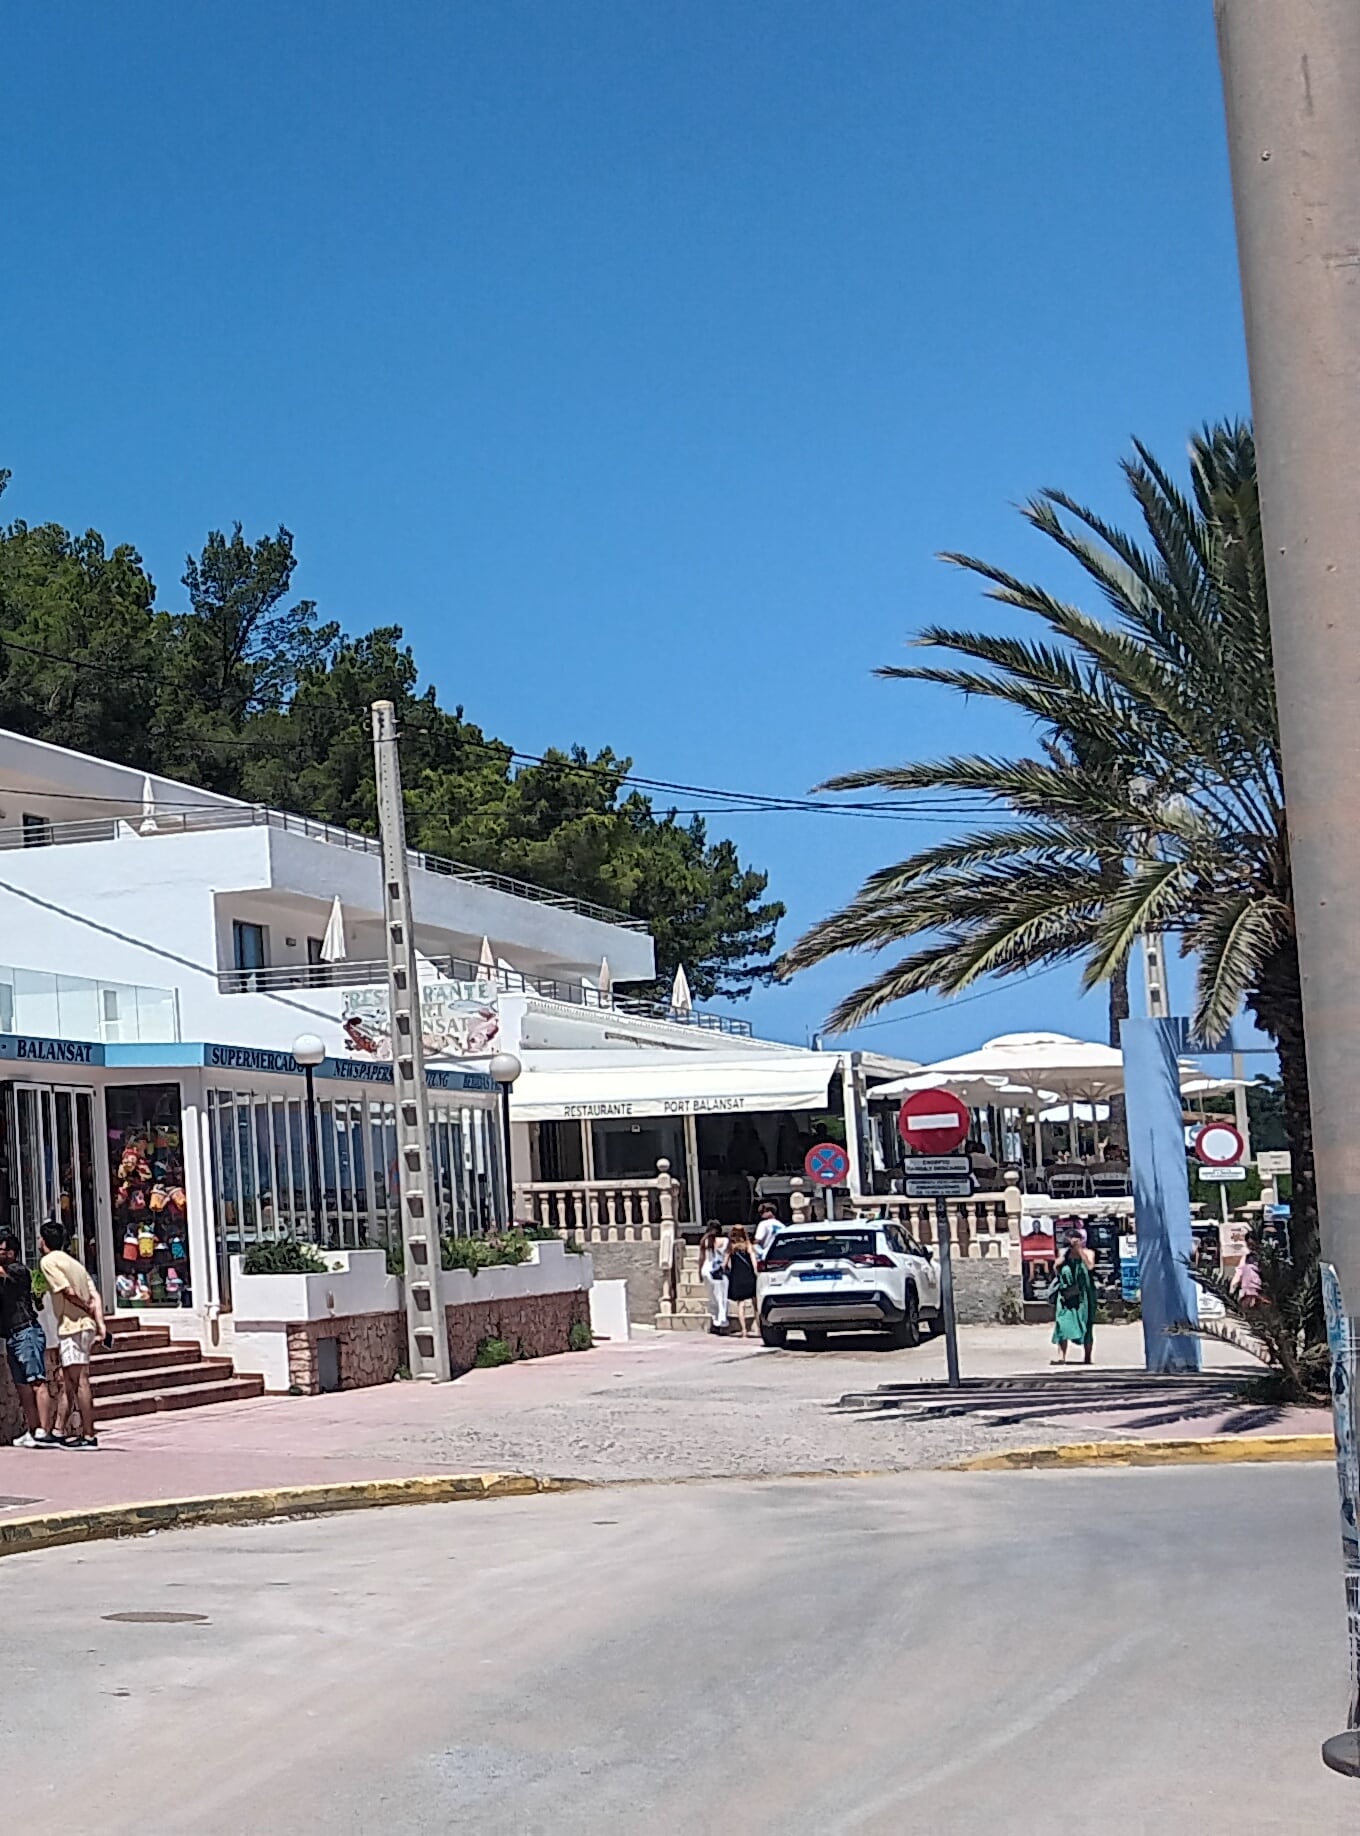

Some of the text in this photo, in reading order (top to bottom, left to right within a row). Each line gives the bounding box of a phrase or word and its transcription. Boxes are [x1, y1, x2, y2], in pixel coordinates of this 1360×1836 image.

[349, 978, 490, 1009] RESRANTE
[17, 1039, 93, 1063] BALANSAT
[564, 1098, 745, 1117] RESTAURANTE PORT BALANSAT
